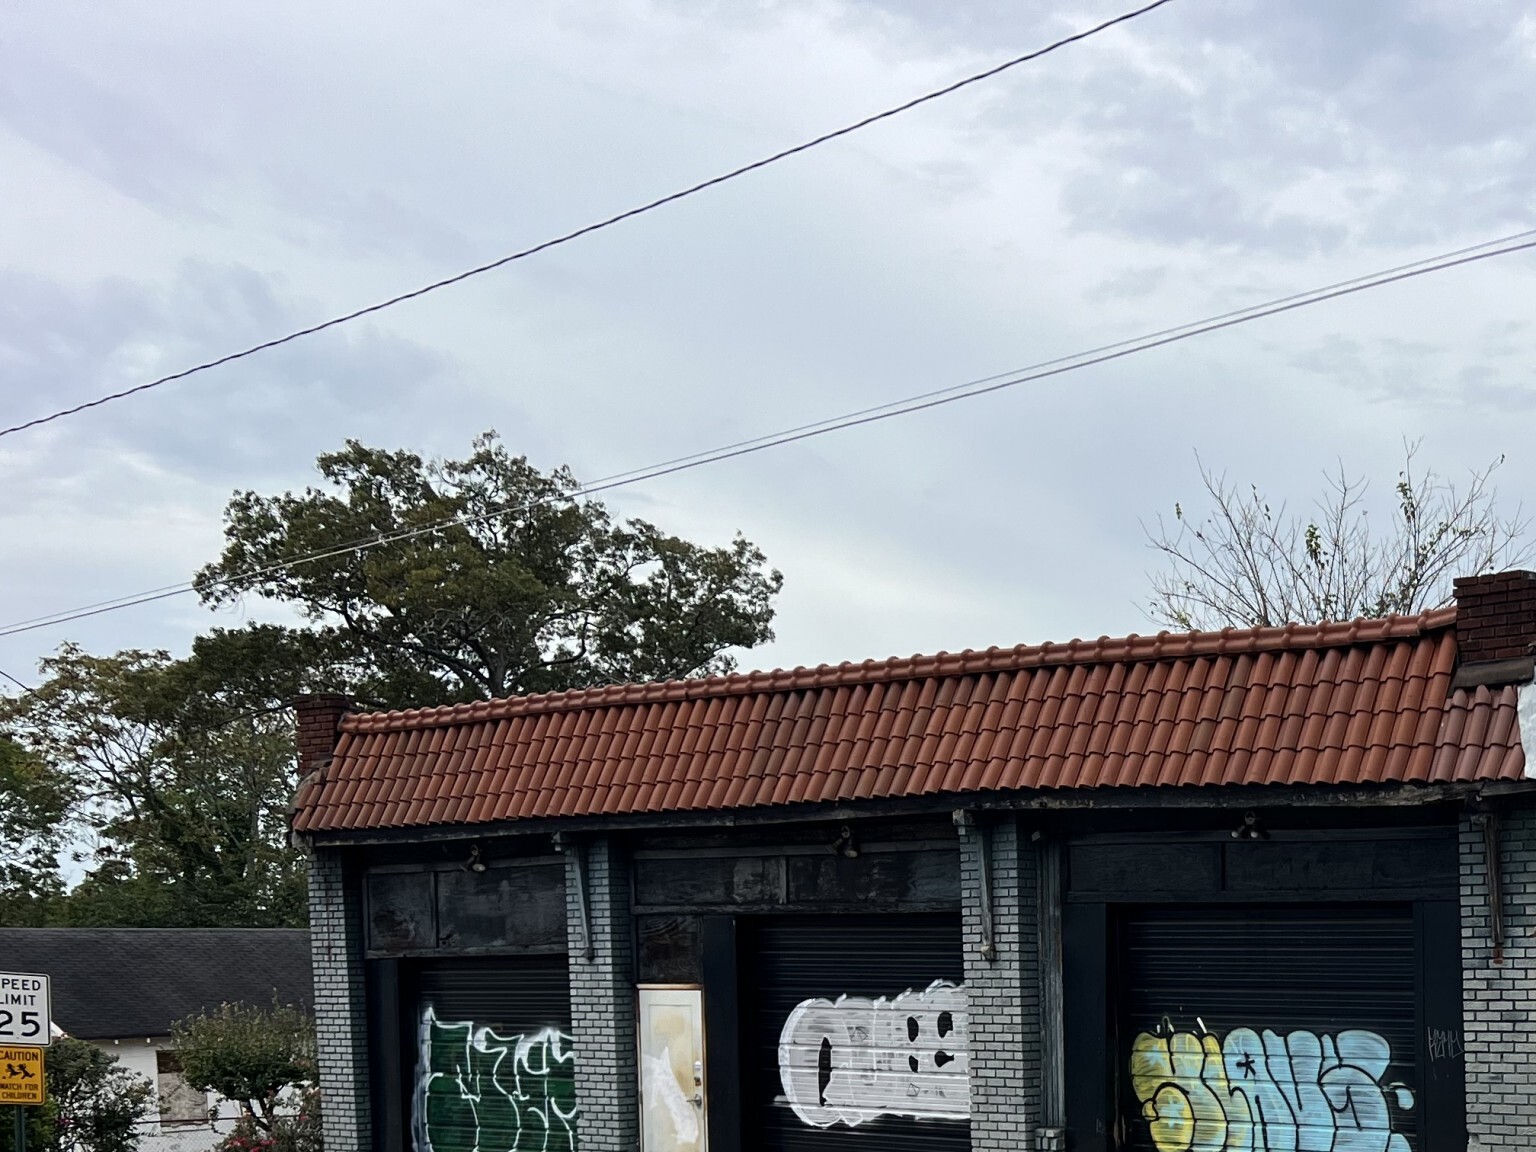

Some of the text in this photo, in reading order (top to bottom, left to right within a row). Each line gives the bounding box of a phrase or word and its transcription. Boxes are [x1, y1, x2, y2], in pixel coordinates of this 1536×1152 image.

[1, 978, 41, 991] PEED
[0, 1010, 41, 1037] 25
[25, 1083, 39, 1091] FOR
[1, 1091, 37, 1099] CHILDREN
